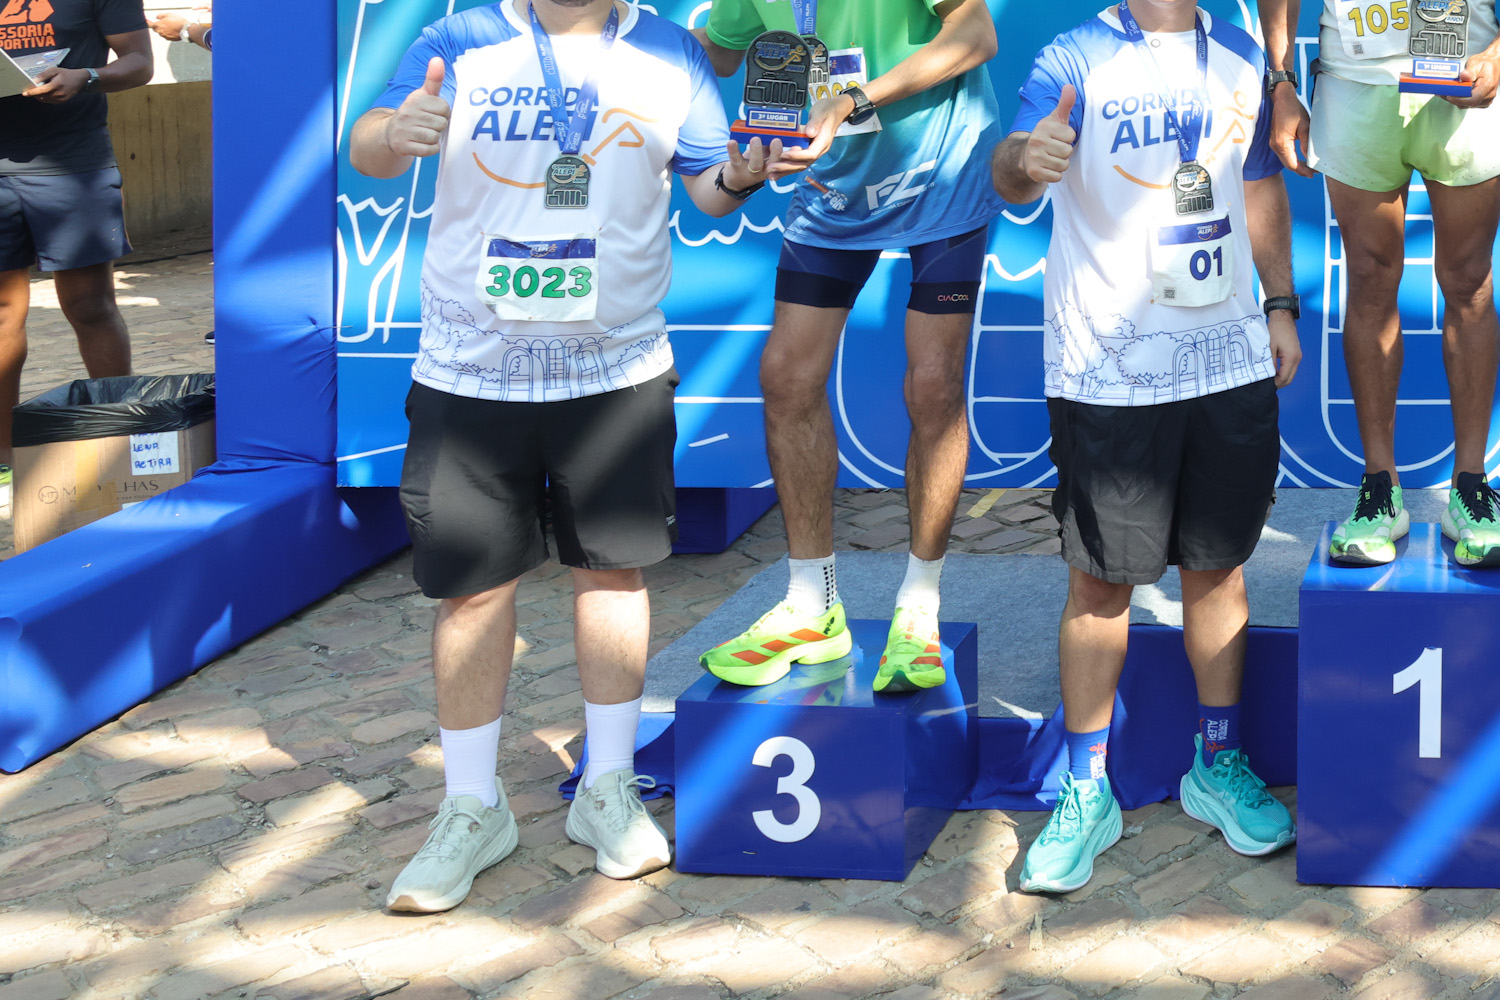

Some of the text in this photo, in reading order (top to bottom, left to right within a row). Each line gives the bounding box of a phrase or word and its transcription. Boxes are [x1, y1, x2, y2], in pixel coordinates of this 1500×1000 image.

[485, 264, 592, 298] 3023
[1189, 245, 1223, 281] 01
[1393, 647, 1442, 758] 1
[752, 735, 821, 843] 3
